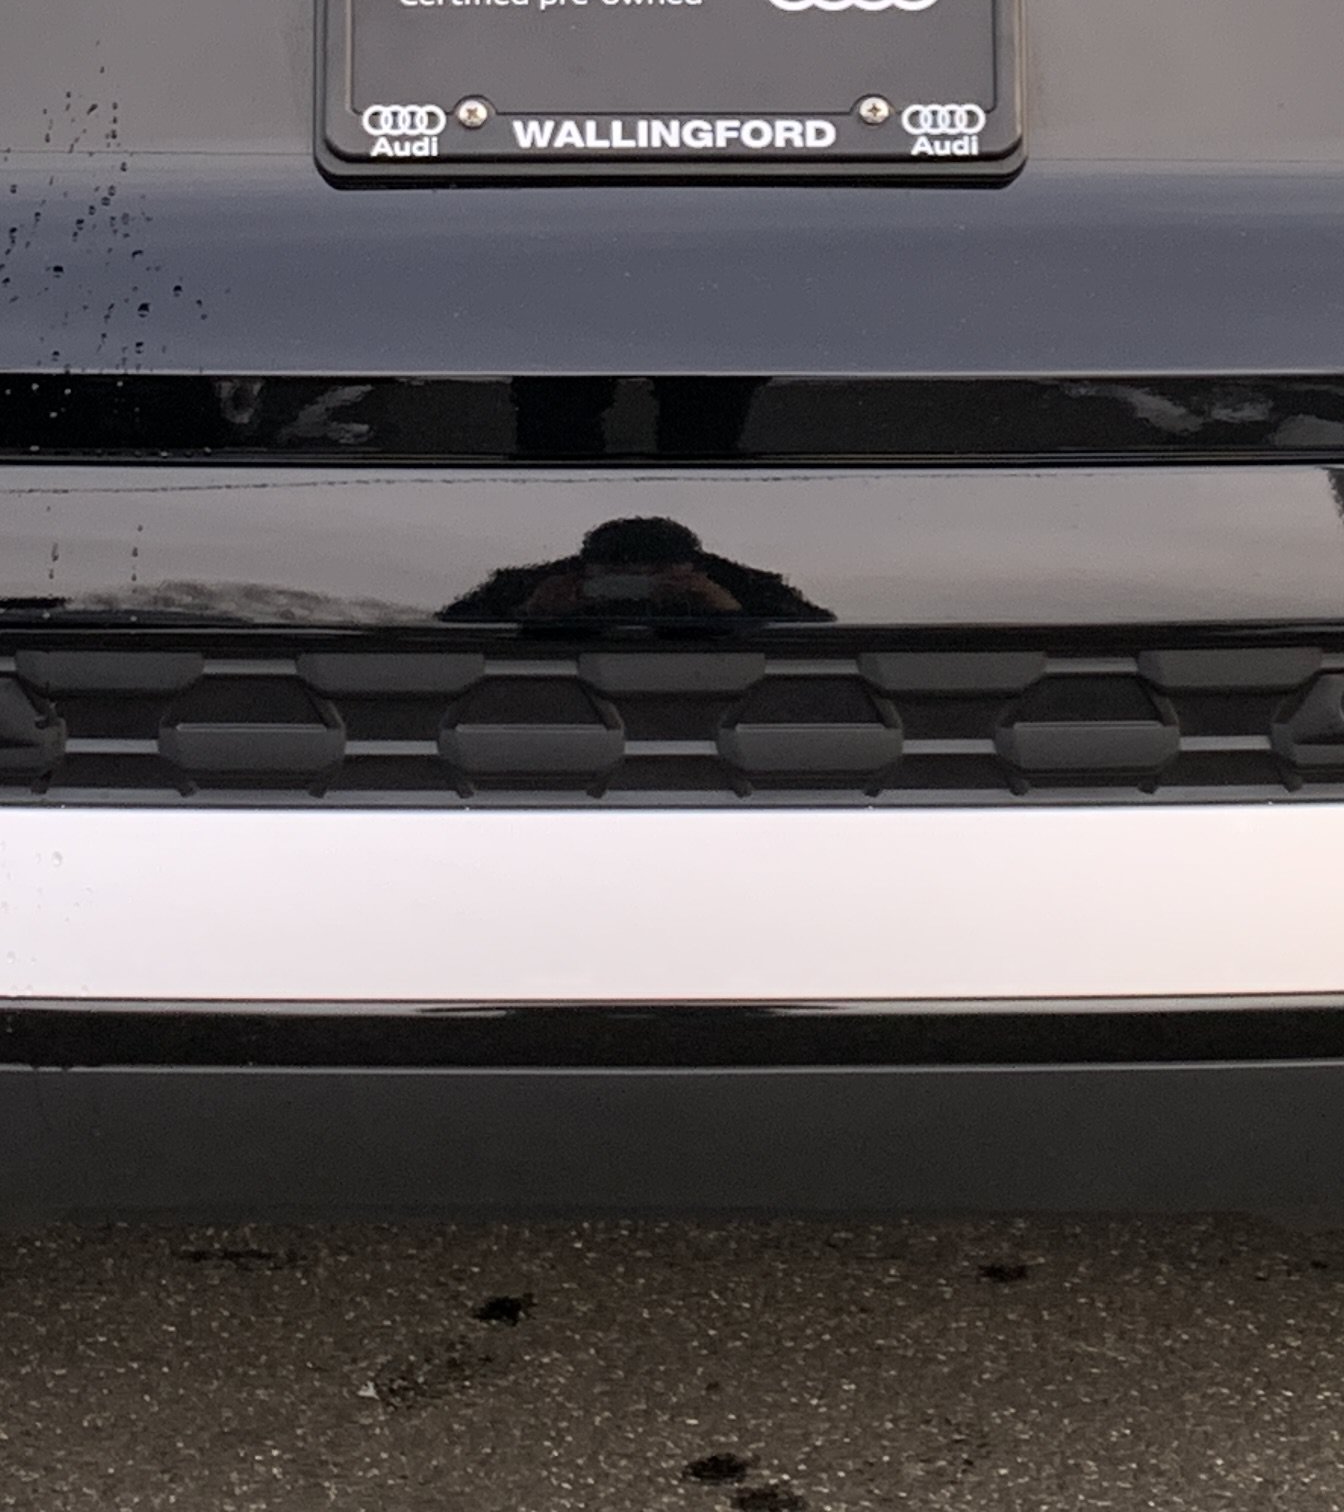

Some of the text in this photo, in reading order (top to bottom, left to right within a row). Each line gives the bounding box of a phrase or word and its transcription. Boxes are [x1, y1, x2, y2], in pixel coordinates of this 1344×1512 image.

[370, 132, 439, 157] Audi
[512, 118, 836, 149] WALLINGFORD
[910, 132, 979, 157] Audi
